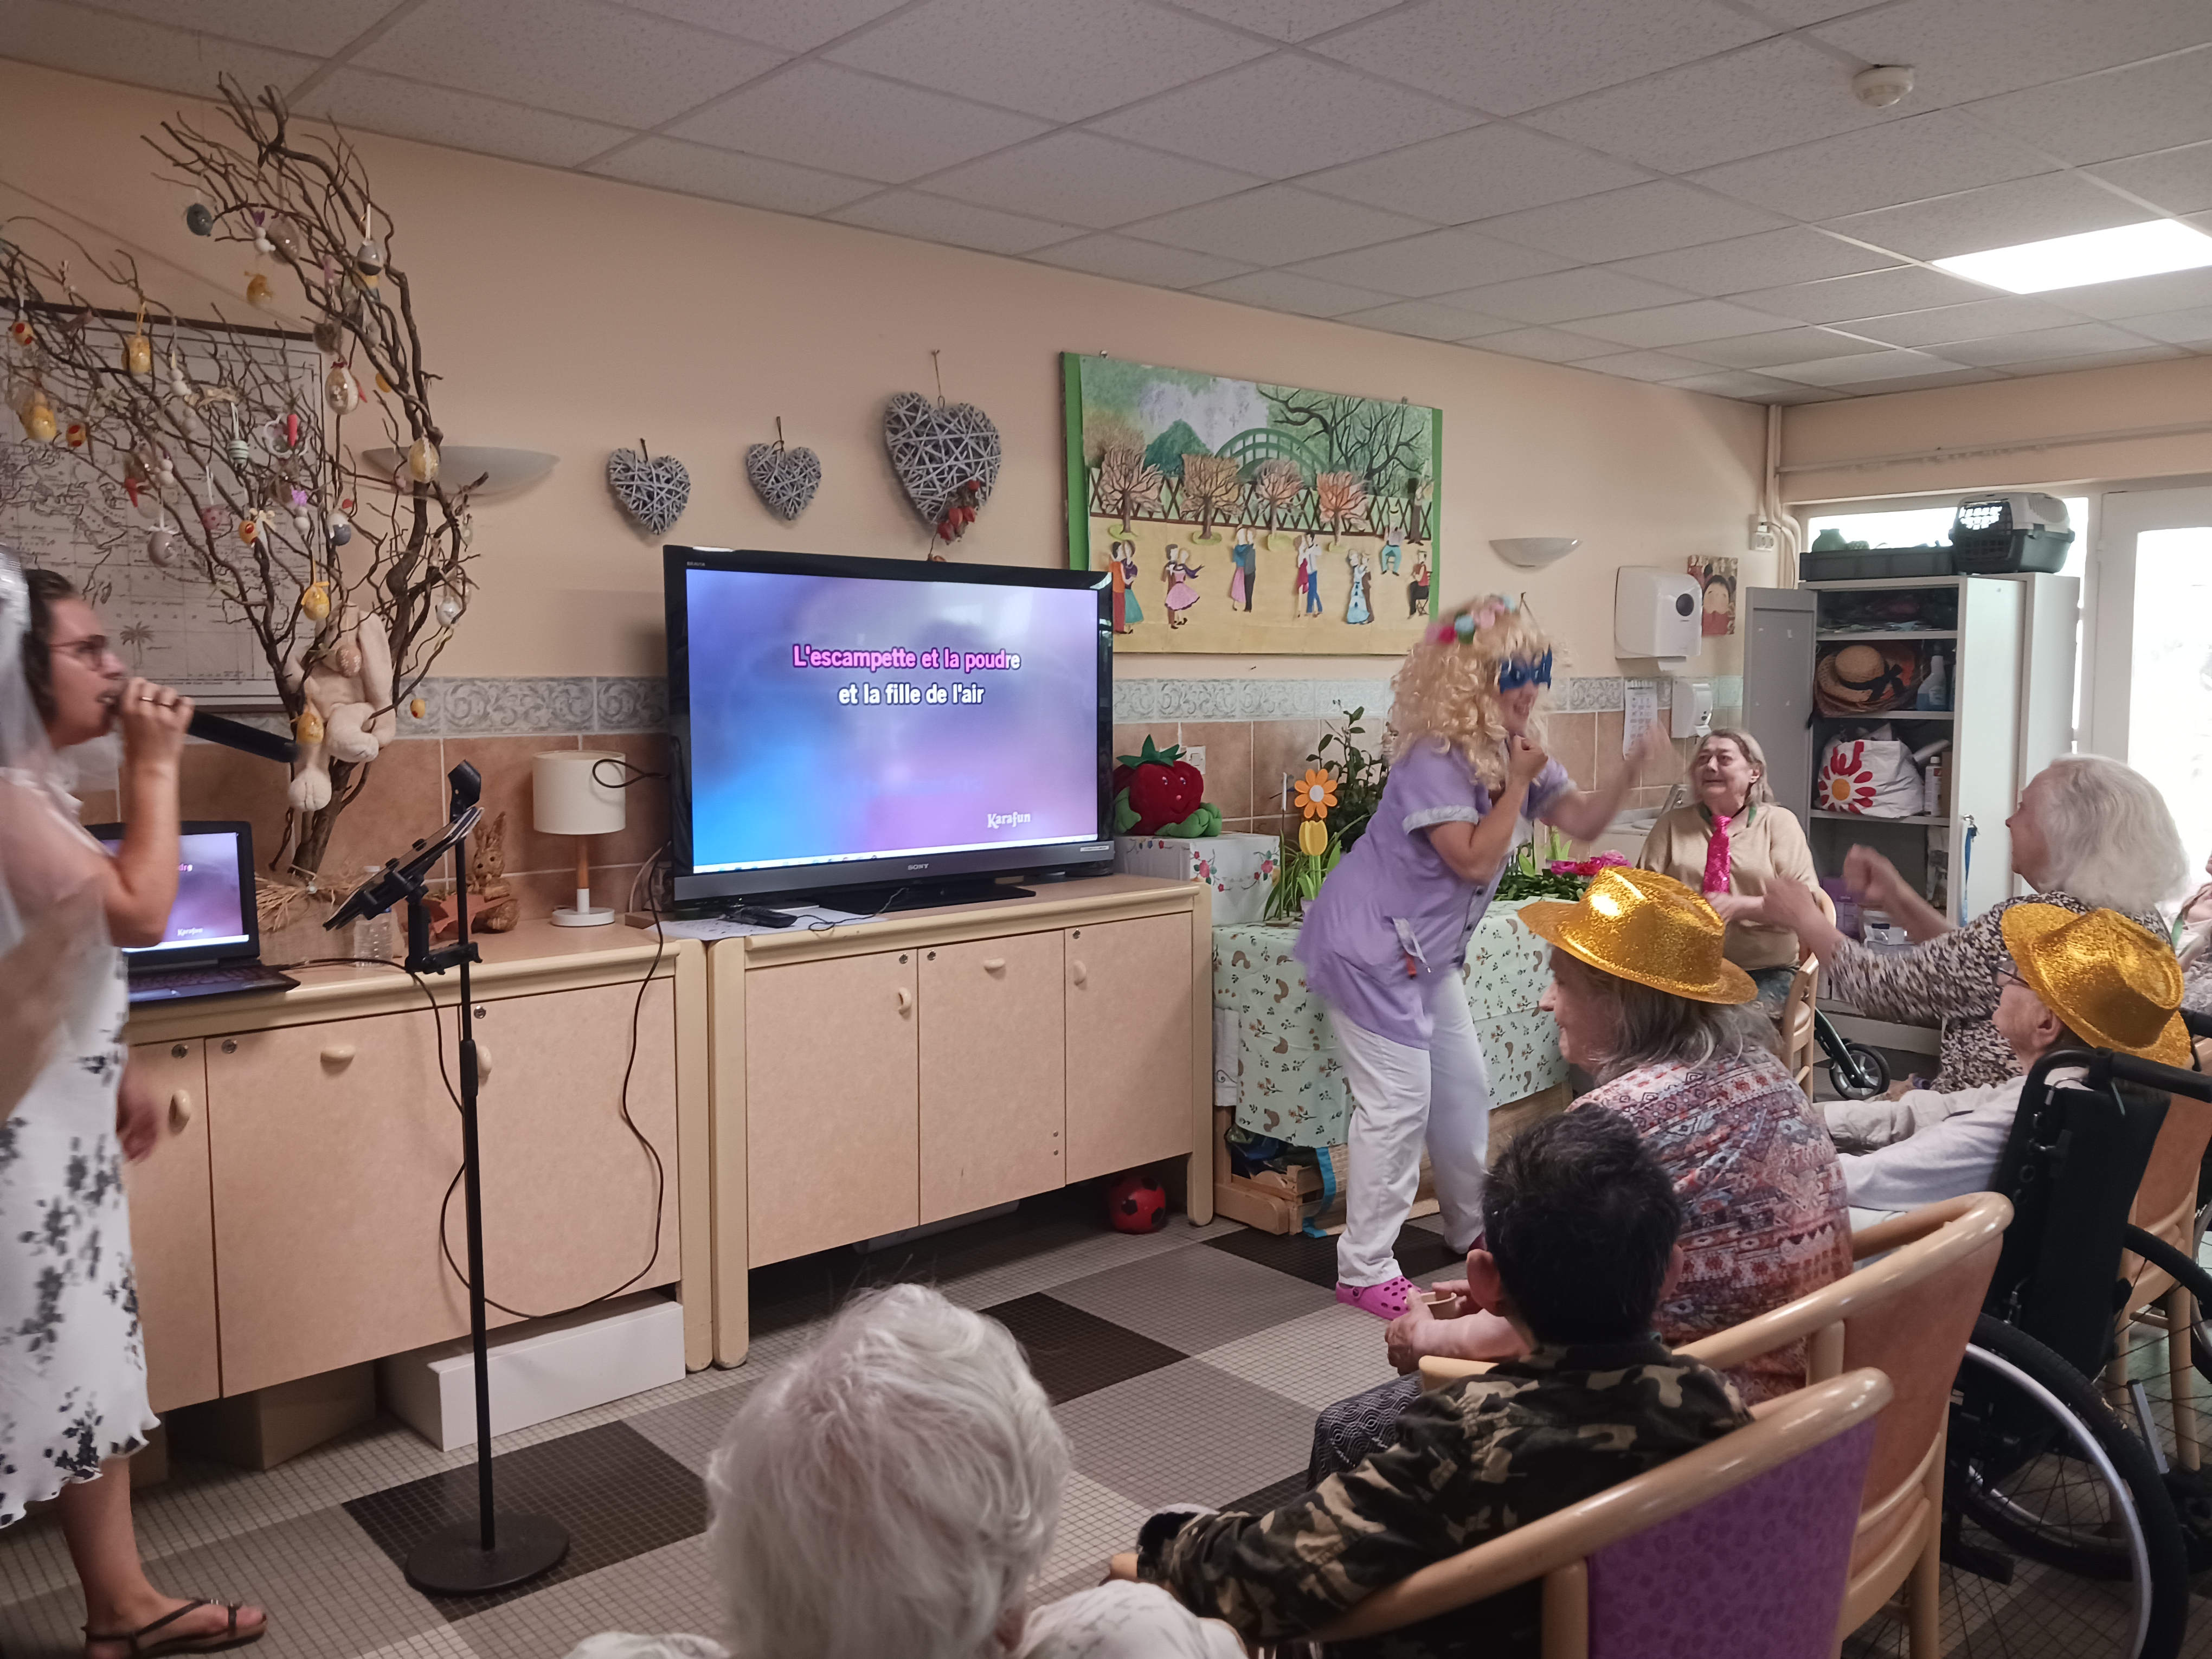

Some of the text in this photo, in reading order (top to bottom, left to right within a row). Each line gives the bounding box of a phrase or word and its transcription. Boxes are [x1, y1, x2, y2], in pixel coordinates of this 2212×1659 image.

[793, 645, 1021, 673] L'escampette et la poudre
[839, 683, 985, 704] et la fille de l'air
[987, 811, 1031, 829] Karafun
